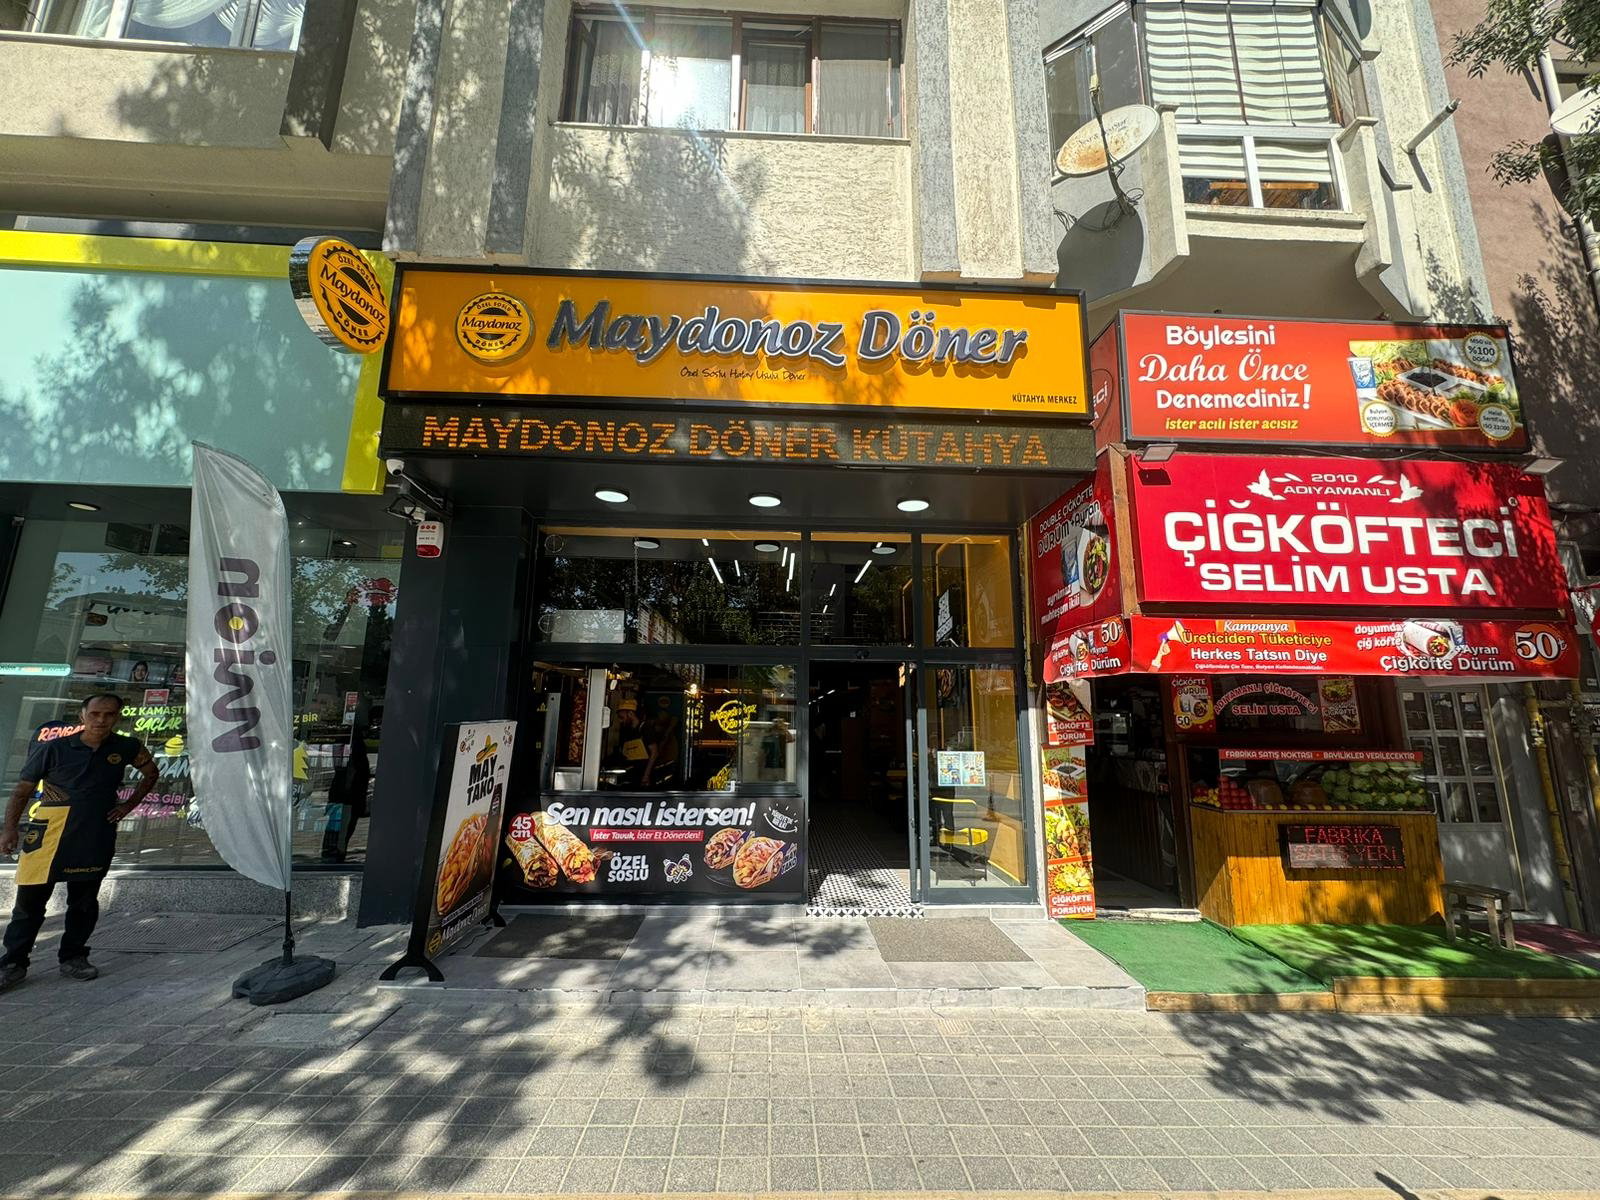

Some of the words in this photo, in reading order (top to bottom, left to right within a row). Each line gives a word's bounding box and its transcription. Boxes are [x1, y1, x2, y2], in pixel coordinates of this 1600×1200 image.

[337, 253, 355, 267] ÖZEL
[320, 264, 386, 329] Maydonoz
[336, 310, 370, 336] DÖNER
[461, 316, 523, 332] Maydonoz
[547, 298, 847, 368] Maydonoz
[857, 309, 1029, 366] Döner
[1165, 324, 1276, 350] Böylesini
[1467, 346, 1496, 356] %100
[1138, 353, 1229, 383] Daha
[1238, 348, 1309, 382] Önce
[1012, 393, 1045, 404] KÜTAHYA
[1048, 394, 1078, 405] MERKEZ
[1156, 384, 1311, 410] Denemediniz!
[1165, 418, 1195, 430] ister
[1198, 417, 1226, 430] acılı
[1228, 418, 1258, 431] ister
[1261, 418, 1299, 430] acısız
[423, 414, 676, 457] MAYDONOZ
[689, 419, 841, 460] DÖNER
[851, 425, 1050, 467] KÜTAHYA
[1311, 473, 1358, 483] 2010
[1283, 485, 1391, 497] ADIYAMANLI
[1040, 509, 1061, 533] DOUBLE
[1037, 520, 1070, 558] DÜRÜM
[1164, 499, 1519, 567] ÇİĞKÖFTECİ
[1200, 555, 1350, 593] SELİM
[1361, 567, 1496, 596] USTA
[1223, 621, 1289, 633] Kampanya
[1183, 629, 1255, 644] Üreticiden
[1259, 633, 1332, 647] Tüketiciye
[1357, 637, 1373, 650] çiğ
[1373, 635, 1402, 648] köfte
[1191, 648, 1241, 660] Herkes
[1246, 648, 1291, 661] Tatsın
[1295, 650, 1328, 663] Diye
[1091, 657, 1121, 671] Dürüm
[1379, 655, 1453, 673] Çiğköfte
[1458, 656, 1515, 671] Dürüm
[121, 706, 136, 717] ÖZ
[138, 705, 186, 716] KAMAŞTI
[1232, 703, 1268, 716] SELİM
[1270, 705, 1302, 716] USTA
[302, 713, 318, 722] BİR
[37, 724, 86, 742] RENGA
[134, 717, 183, 734] SAÇLAR
[1051, 720, 1091, 731] ÇİĞKÖFTE
[1057, 730, 1087, 741] DÜRÜM
[1225, 750, 1257, 758] FABRİKA
[1258, 751, 1279, 760] SATIŞ
[1281, 751, 1313, 759] NOKTASI
[469, 754, 498, 787] MAY
[161, 792, 186, 804] GİBİ
[466, 778, 494, 806] TAKO
[544, 802, 590, 826] Sen
[592, 802, 652, 826] nasıl
[655, 801, 756, 826] istersen!
[512, 816, 532, 830] 45
[511, 829, 532, 839] cm
[1304, 828, 1384, 844] FABRİKA
[1356, 845, 1400, 861] YERİ
[610, 852, 647, 870] ÖZEL
[608, 868, 650, 883] SOSLU
[1052, 893, 1092, 905] ÇİĞKÖFTE
[1052, 904, 1093, 915] PORSİYON
